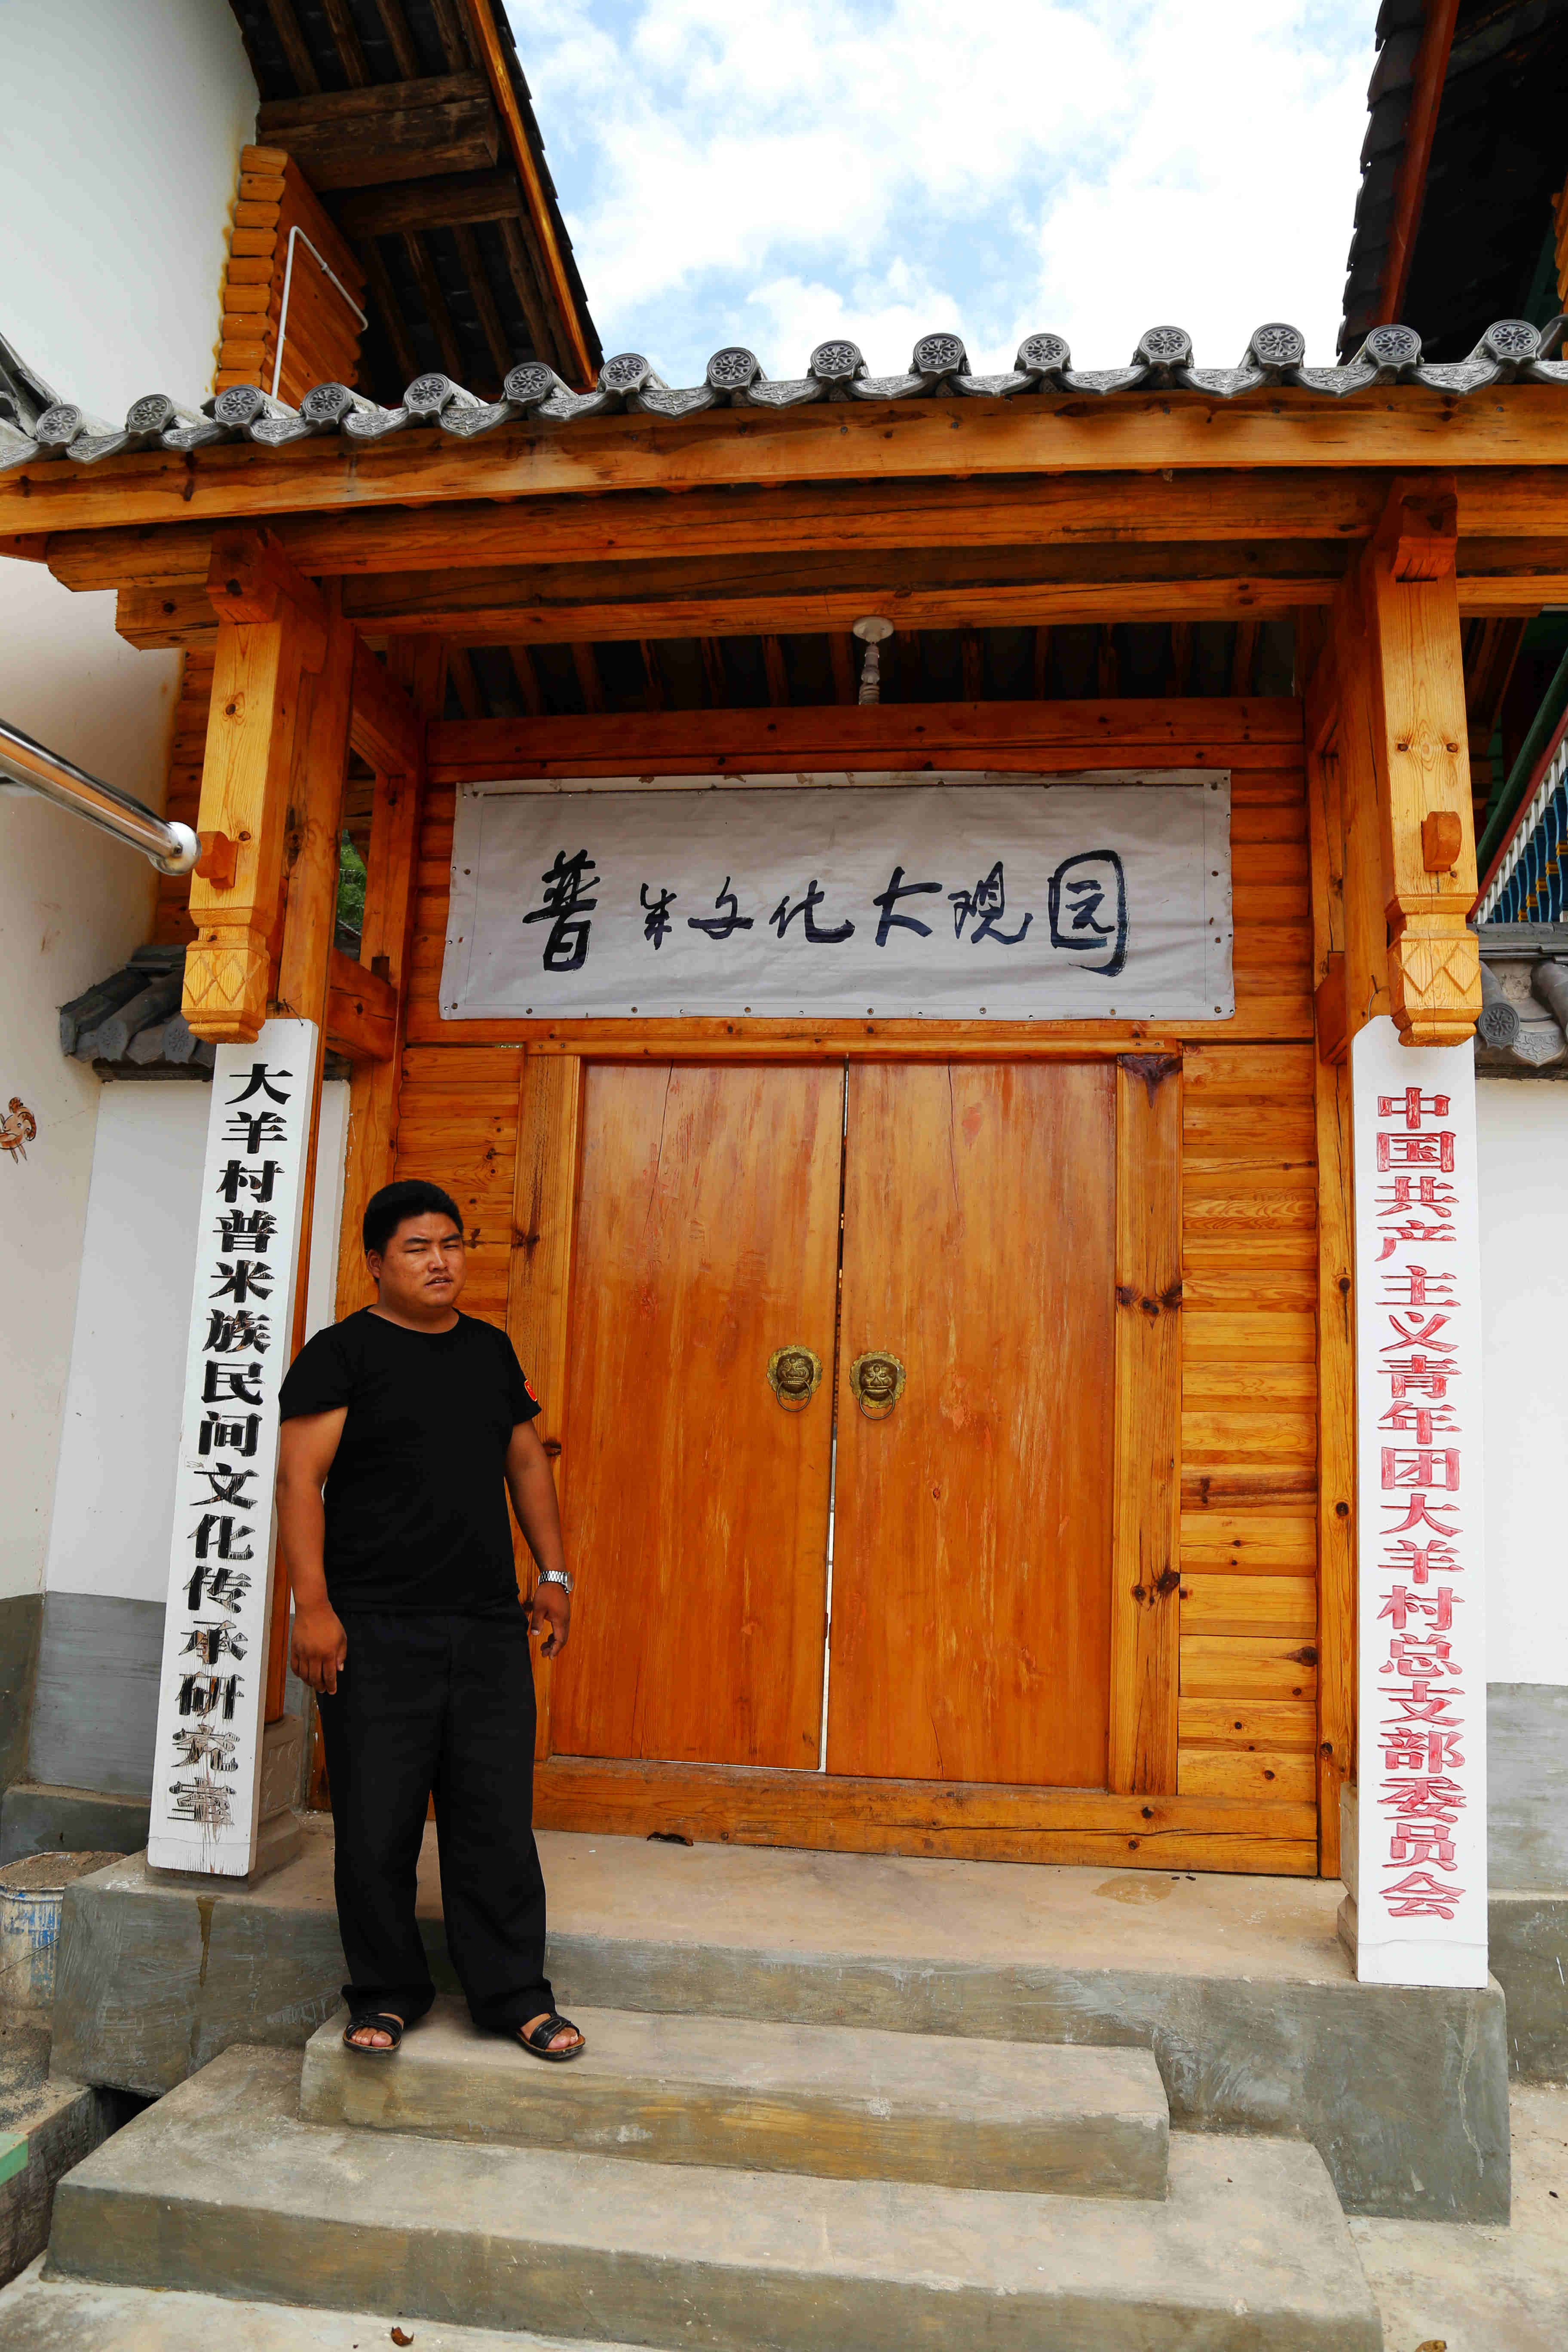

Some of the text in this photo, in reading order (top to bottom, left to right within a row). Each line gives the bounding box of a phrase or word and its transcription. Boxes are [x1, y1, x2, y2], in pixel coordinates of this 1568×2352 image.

[522, 849, 1128, 977] 普米文化大观园
[167, 1063, 294, 1825] 大羊村普米族民间文化传承研究室
[1374, 1087, 1467, 1920] 中国共产主义青年团大羊村总支部委员会
